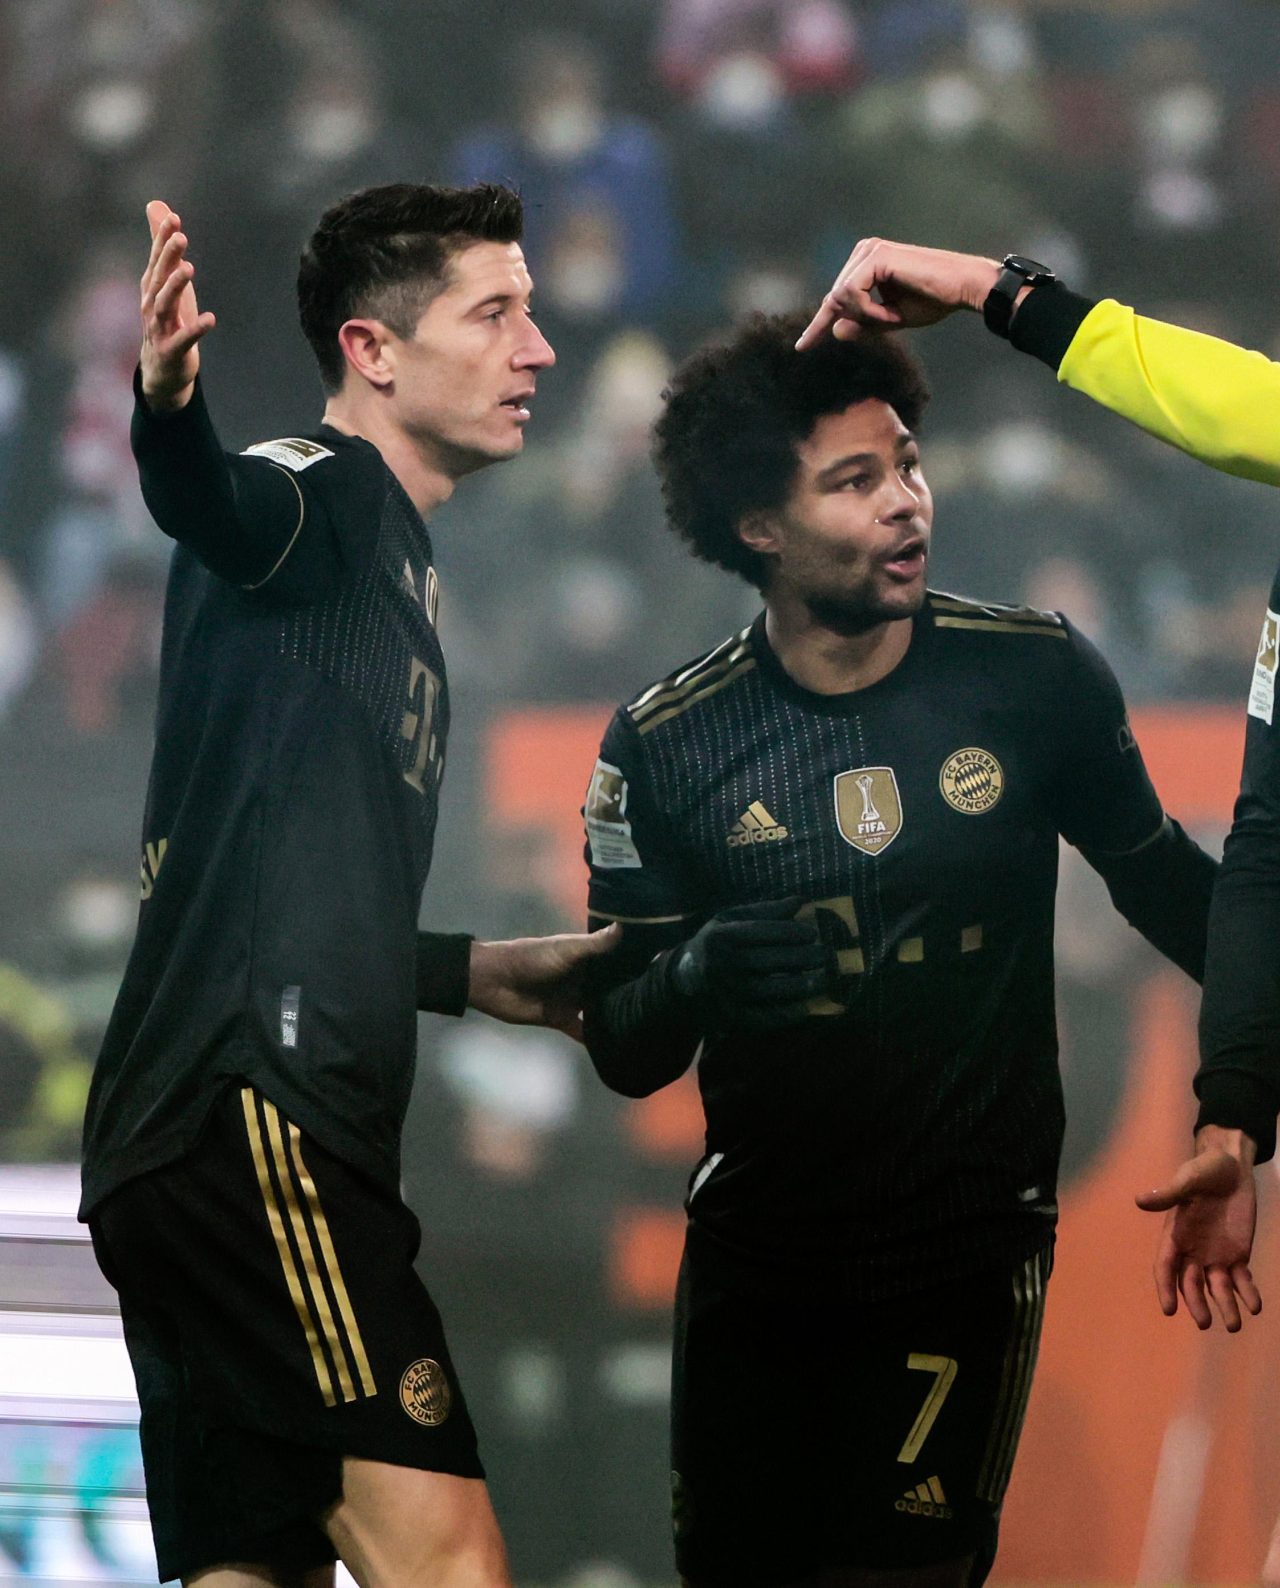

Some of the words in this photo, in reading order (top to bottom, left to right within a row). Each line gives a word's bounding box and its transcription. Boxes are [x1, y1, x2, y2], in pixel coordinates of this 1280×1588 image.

[946, 764, 957, 780] FC
[955, 752, 998, 775] BAYERN
[726, 826, 789, 848] adidas
[857, 821, 886, 834] FIFA
[405, 1375, 415, 1391] FC
[896, 1352, 959, 1464] 7
[895, 1498, 954, 1520] adidas
